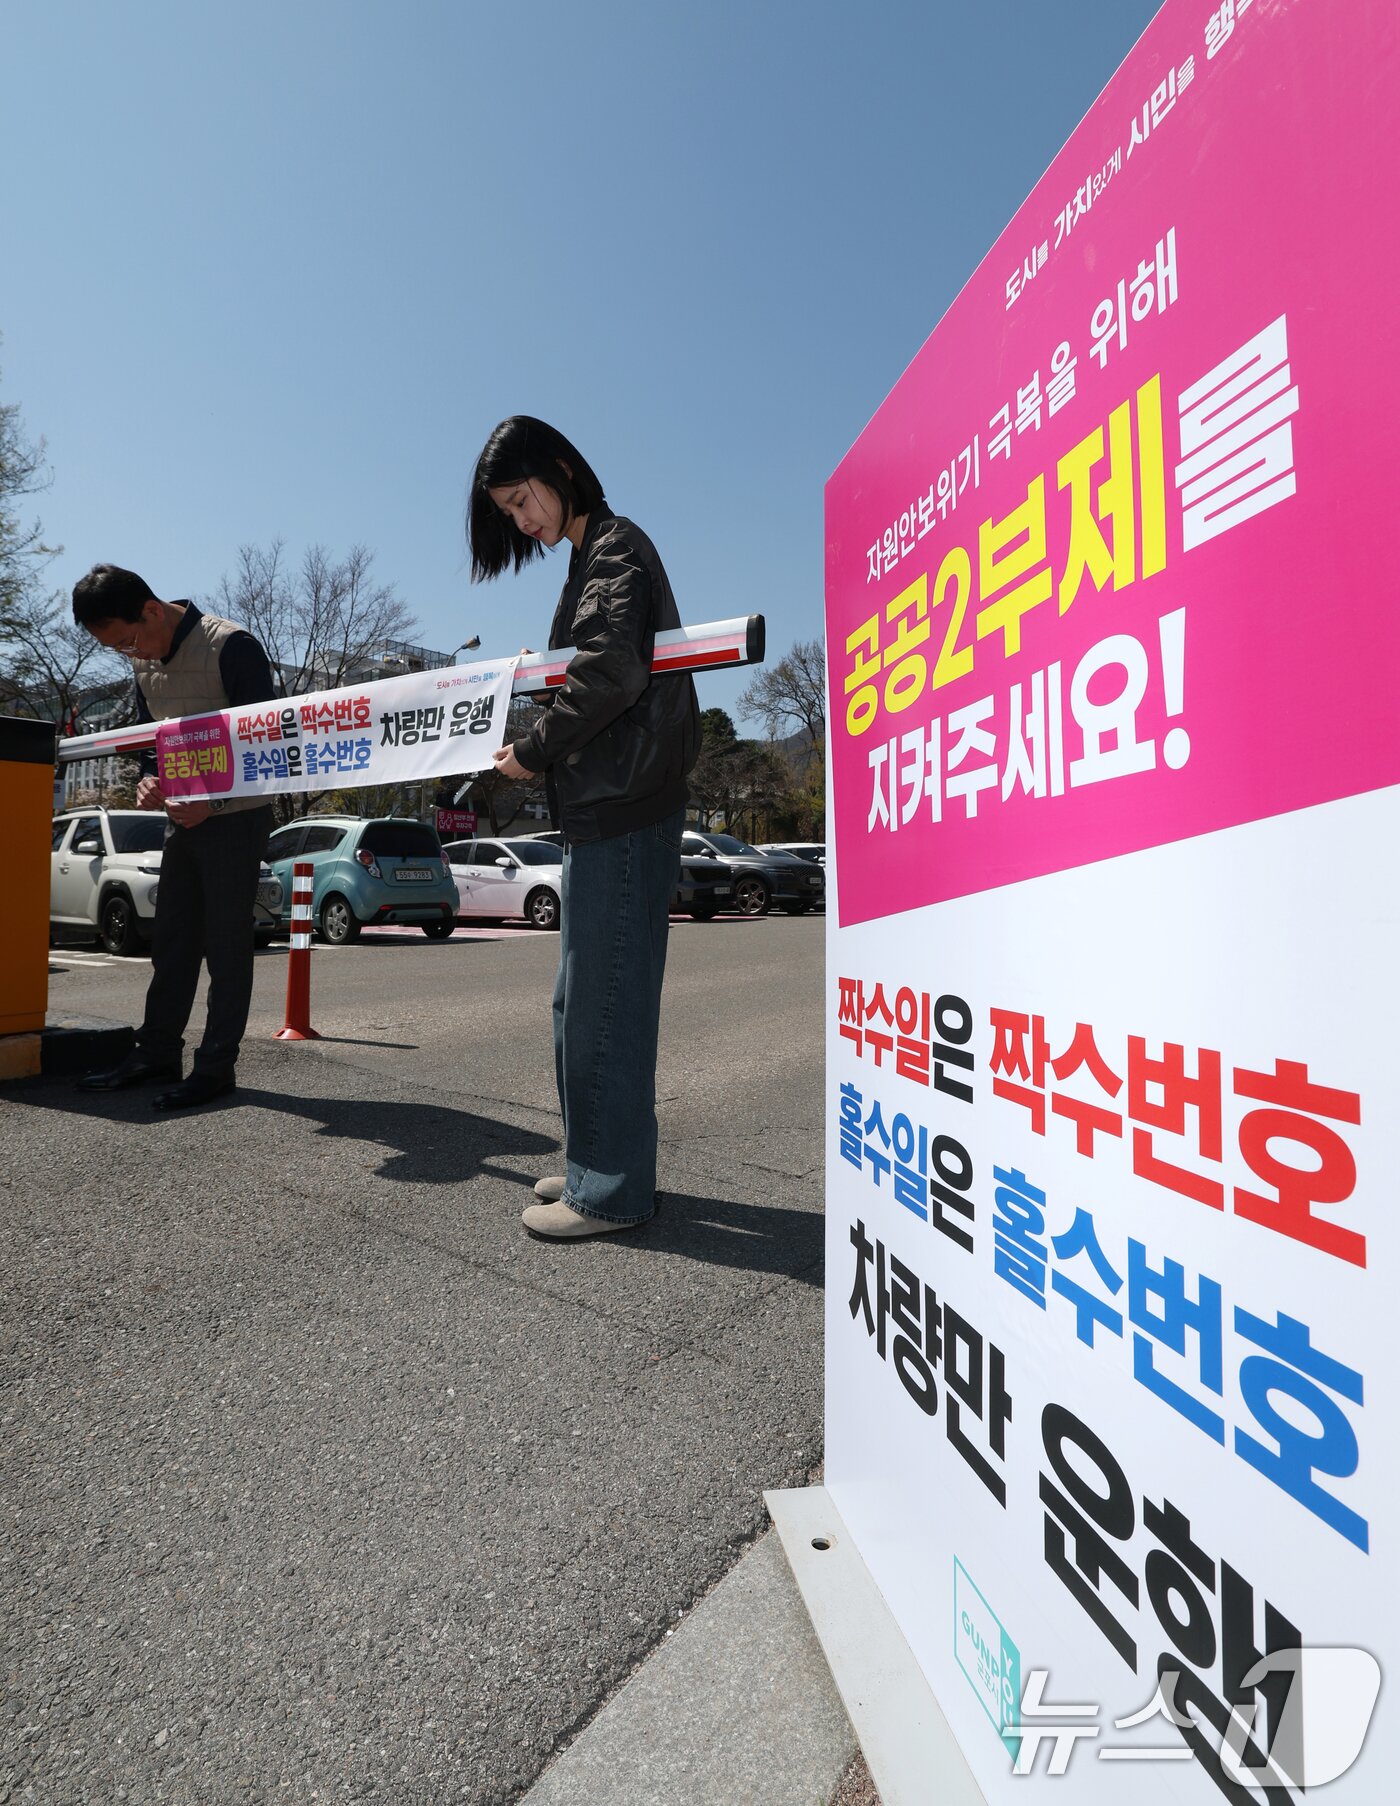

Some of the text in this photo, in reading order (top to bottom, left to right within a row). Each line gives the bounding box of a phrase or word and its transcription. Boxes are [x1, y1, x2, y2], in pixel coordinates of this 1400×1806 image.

[1006, 0, 1254, 312] 도시를 가치있게 시민을 행
[866, 226, 1178, 584] 자원안보위기 극복을 위해
[844, 312, 1300, 737] 공공2부제를
[163, 745, 228, 780] 공공2부제
[193, 730, 209, 742] 극복을
[209, 727, 221, 740] 위한
[237, 695, 372, 745] 짝수일은 짝수번호
[241, 737, 372, 782] 홀수일은 홀수번호
[380, 694, 495, 748] 차량만 운행
[867, 606, 1191, 834] 지켜주세요!
[837, 976, 1367, 1270] 짝수일은 짝수번호
[838, 1081, 1370, 1556] 홀수일은 홀수번호
[848, 1217, 1306, 1806] 차량만 운행
[977, 1656, 999, 1705] 군포시
